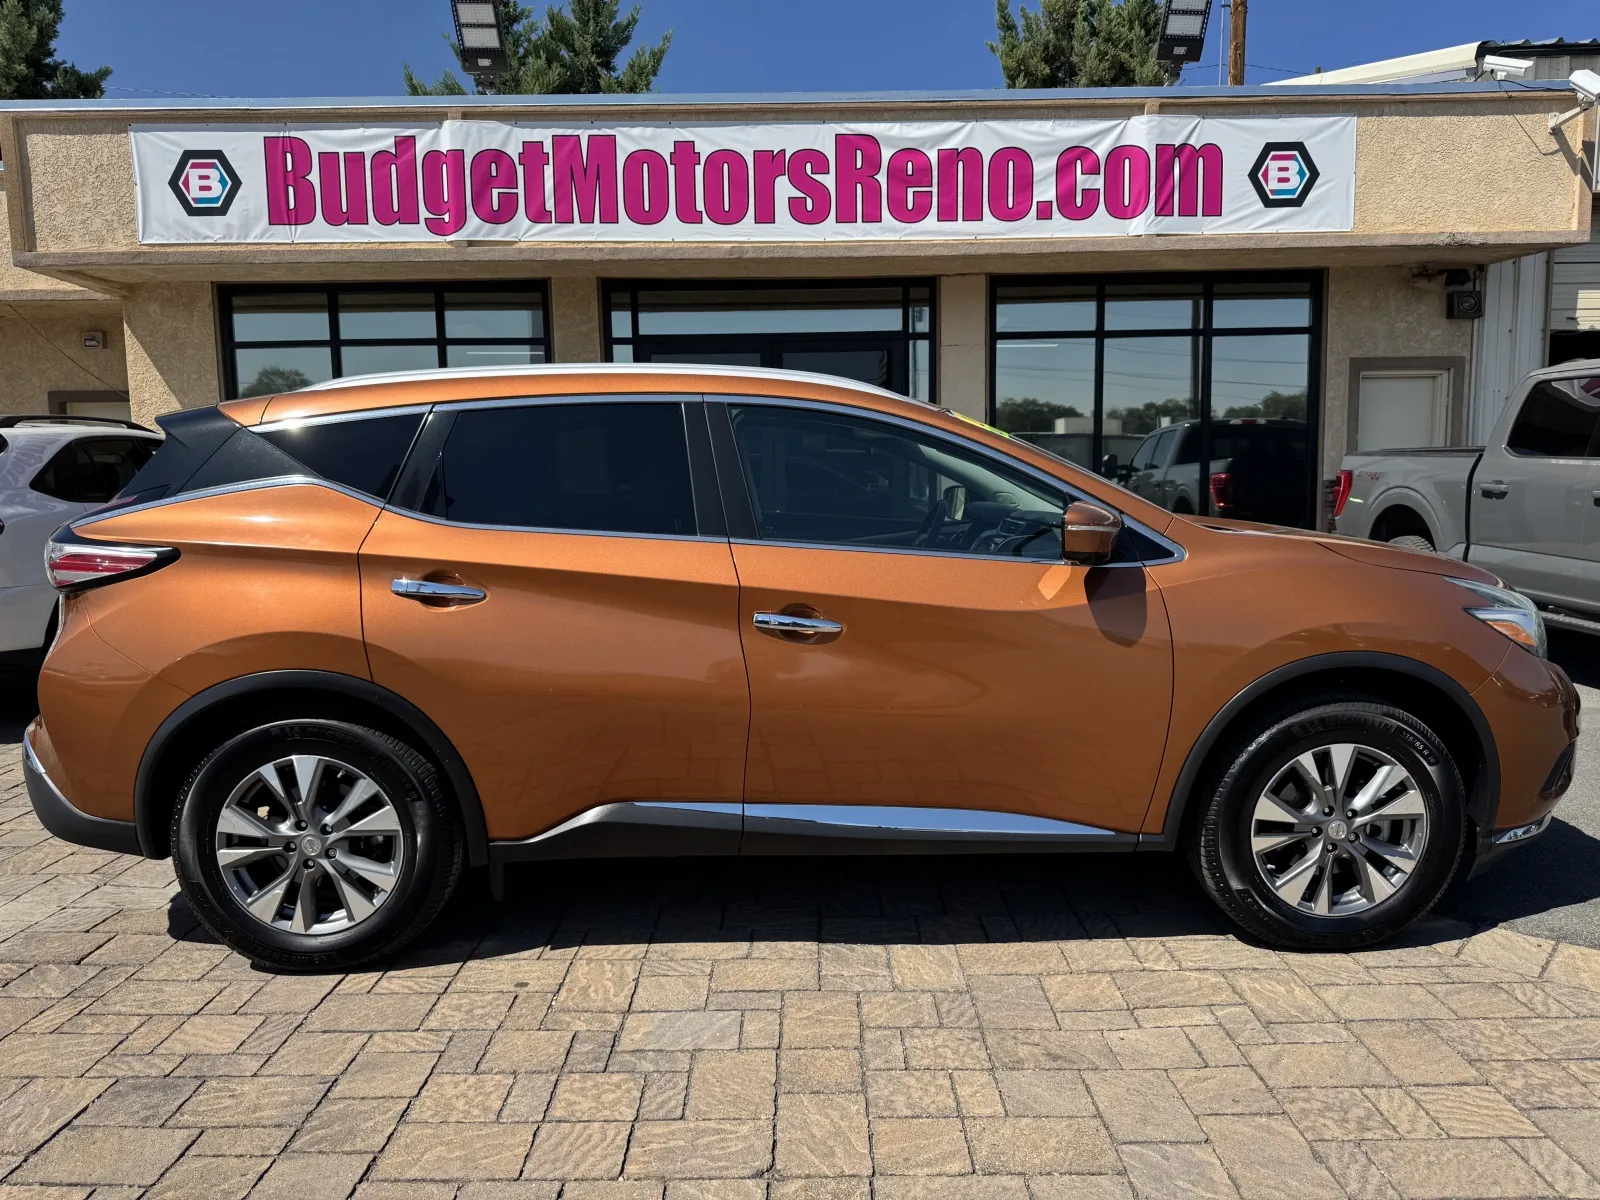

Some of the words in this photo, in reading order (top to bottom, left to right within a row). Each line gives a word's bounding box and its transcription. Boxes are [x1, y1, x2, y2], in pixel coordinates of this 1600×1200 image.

[188, 168, 222, 198] B
[263, 133, 1223, 236] BudgetMotorsReno.com
[1267, 160, 1301, 190] B
